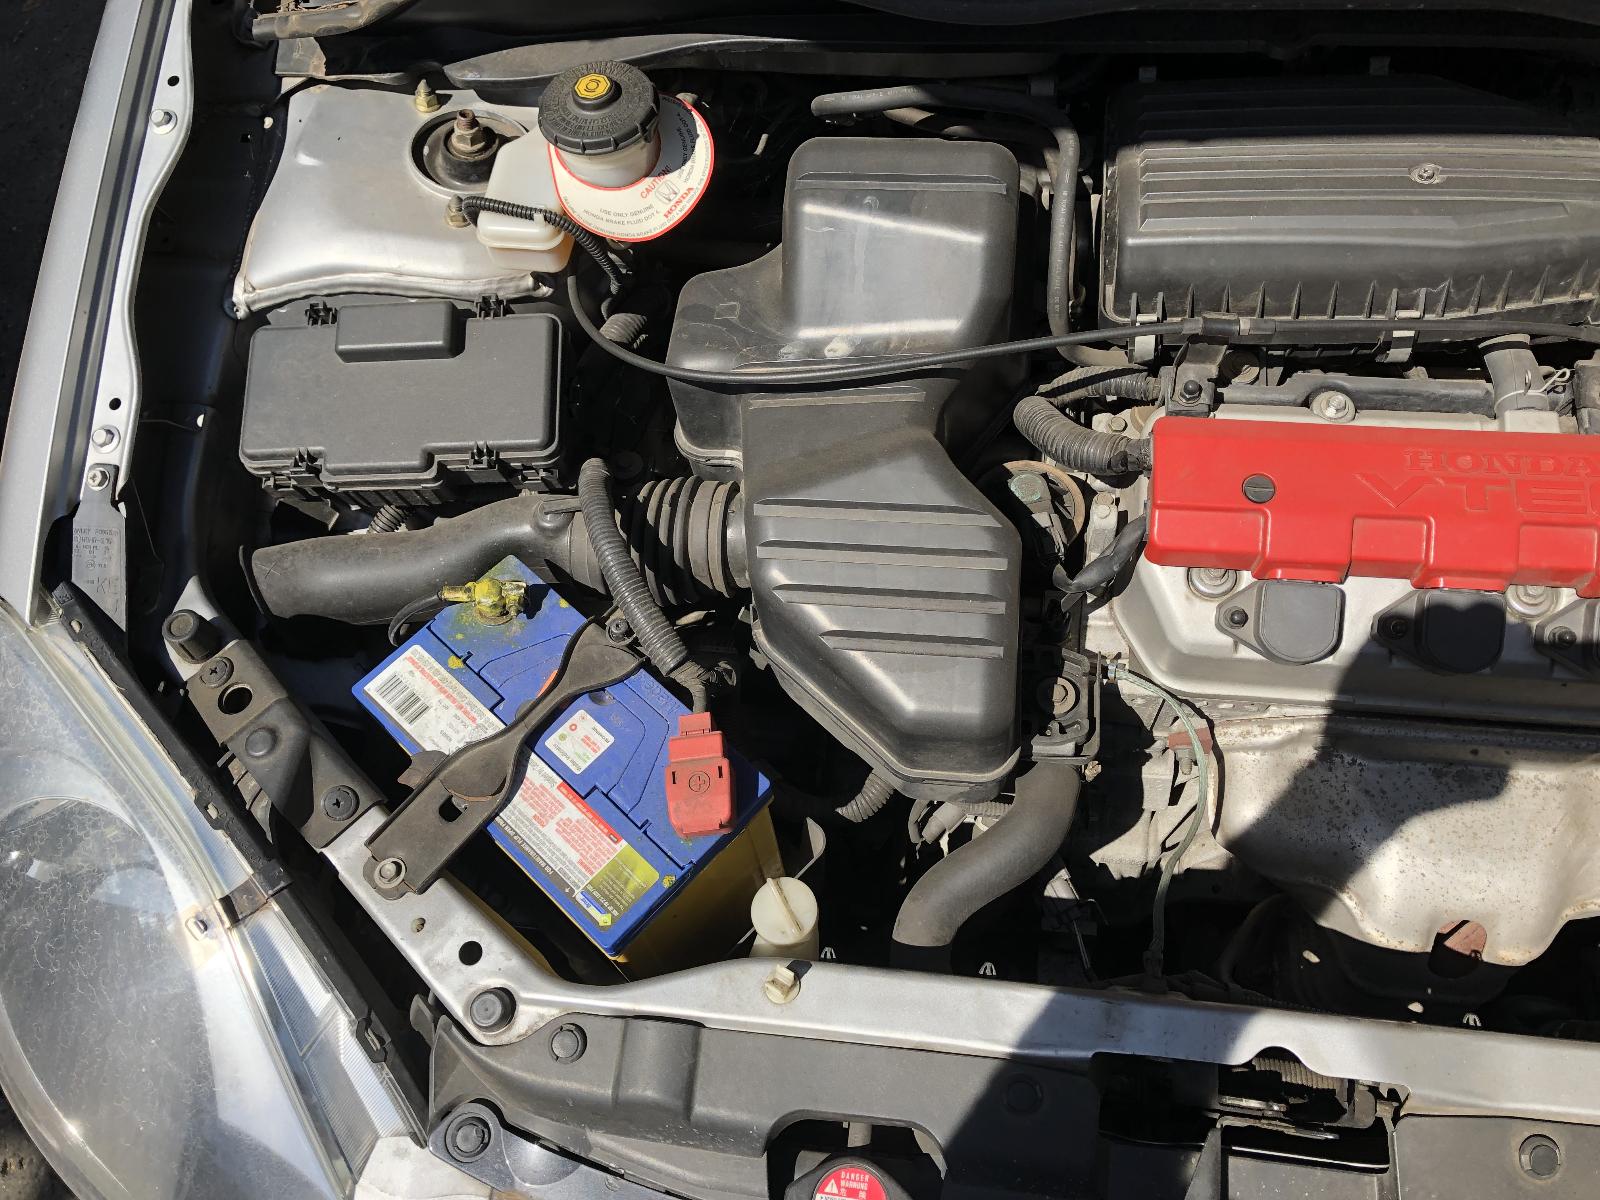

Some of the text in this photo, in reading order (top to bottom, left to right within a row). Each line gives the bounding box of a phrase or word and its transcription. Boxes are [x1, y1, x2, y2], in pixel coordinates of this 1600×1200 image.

[600, 208, 612, 216] USE
[629, 203, 655, 217] GENUINE
[663, 187, 695, 219] HONDA
[605, 218, 626, 226] BRAKE
[1404, 448, 1600, 475] HONDA
[1352, 472, 1600, 515] VTE
[841, 1171, 870, 1182] DANGER
